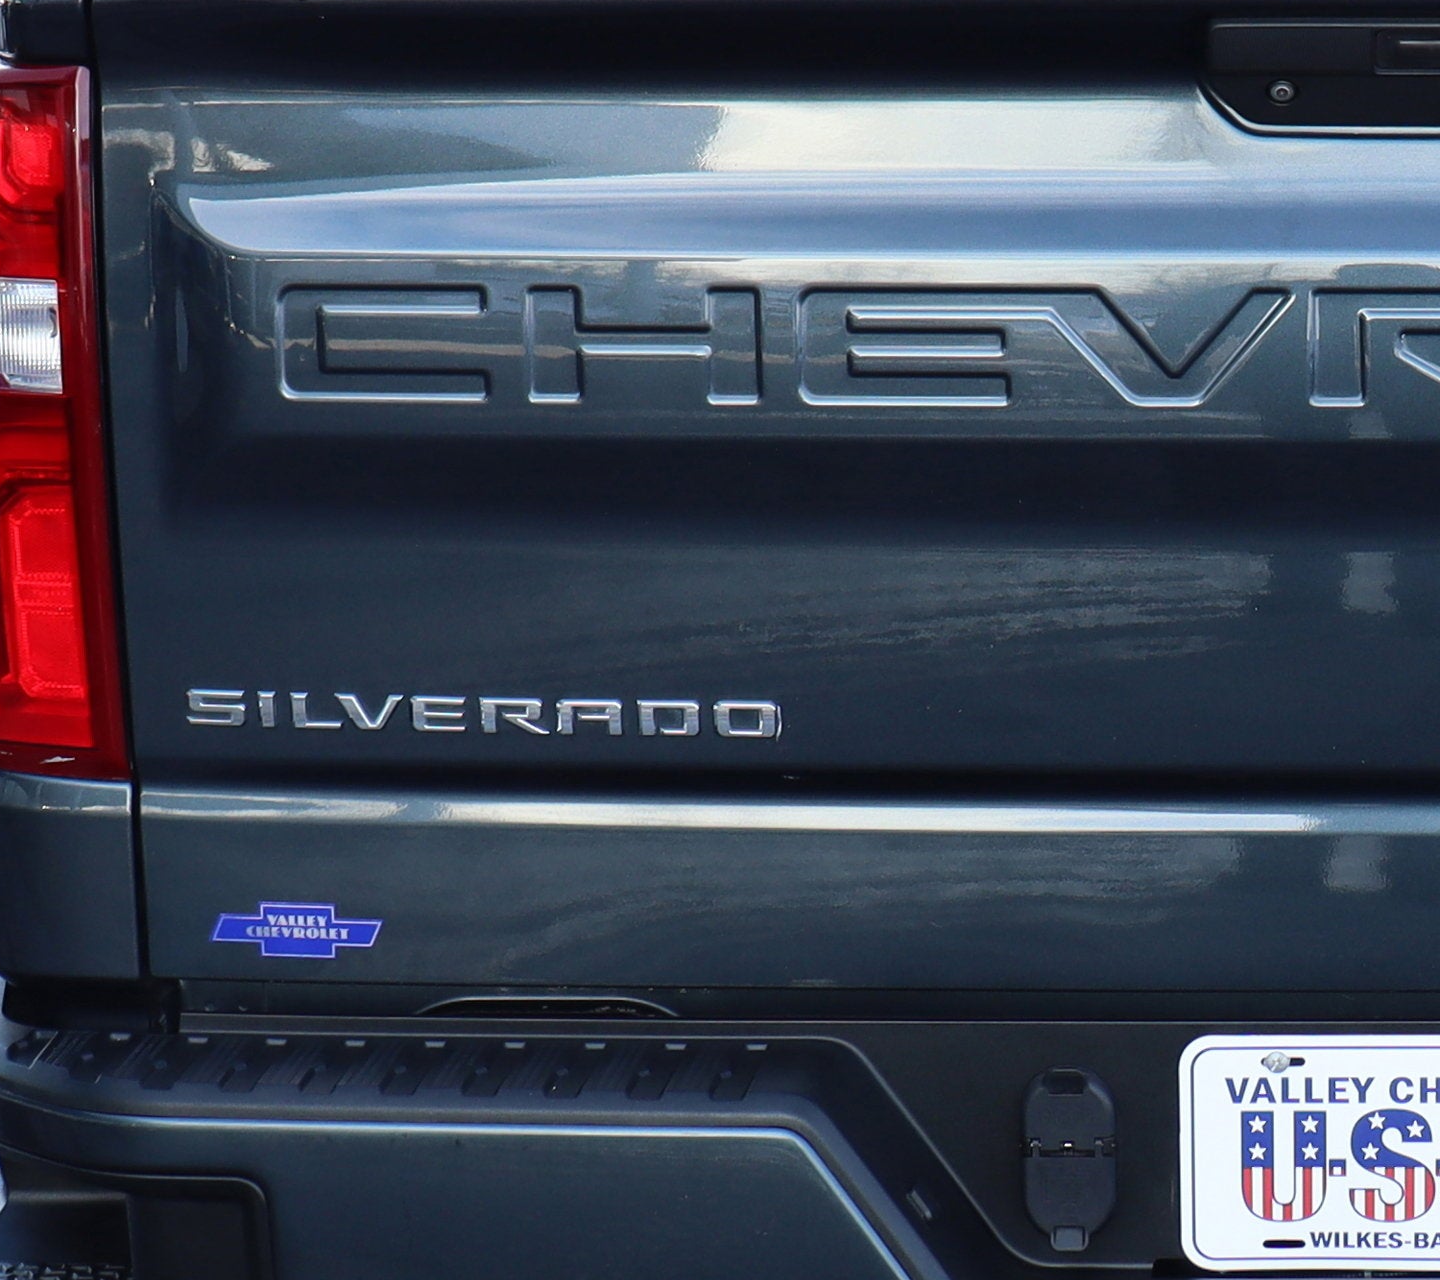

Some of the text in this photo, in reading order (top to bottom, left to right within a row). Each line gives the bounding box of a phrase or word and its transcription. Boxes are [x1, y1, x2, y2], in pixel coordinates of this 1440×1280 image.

[185, 688, 781, 738] SILVERADO
[266, 914, 328, 927] VALLEY
[245, 925, 350, 940] CHEVROLET
[1225, 1077, 1375, 1104] VALLEY
